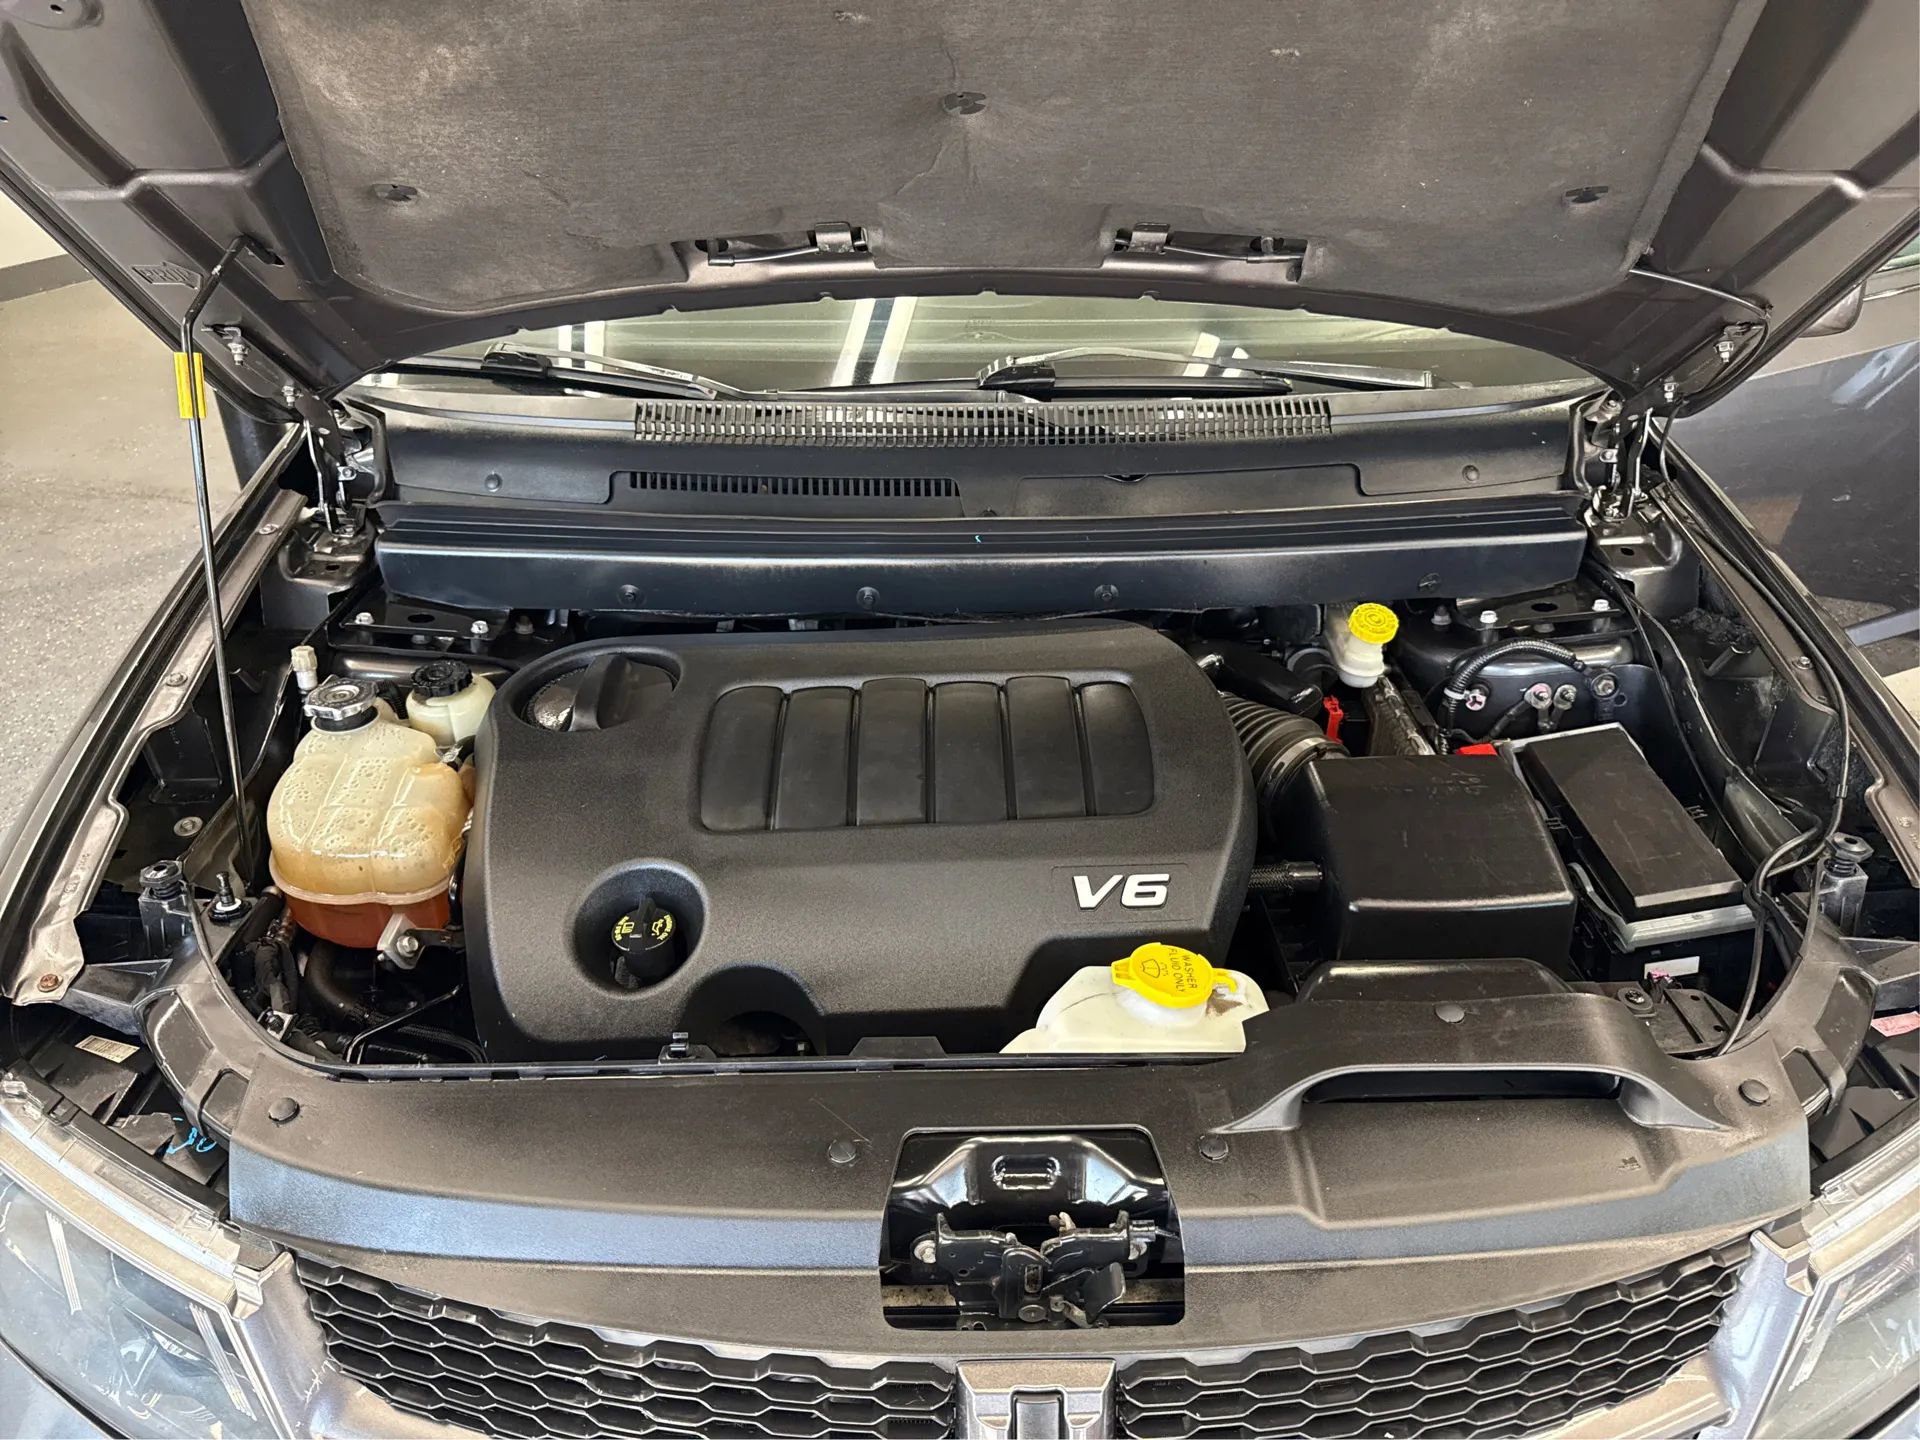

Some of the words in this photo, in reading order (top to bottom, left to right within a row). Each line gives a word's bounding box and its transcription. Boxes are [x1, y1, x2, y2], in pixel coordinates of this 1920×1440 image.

[1072, 873, 1171, 910] V6
[1169, 948, 1181, 970] FLUID
[1181, 955, 1198, 989] WASHER
[1173, 972, 1186, 992] ONLY
